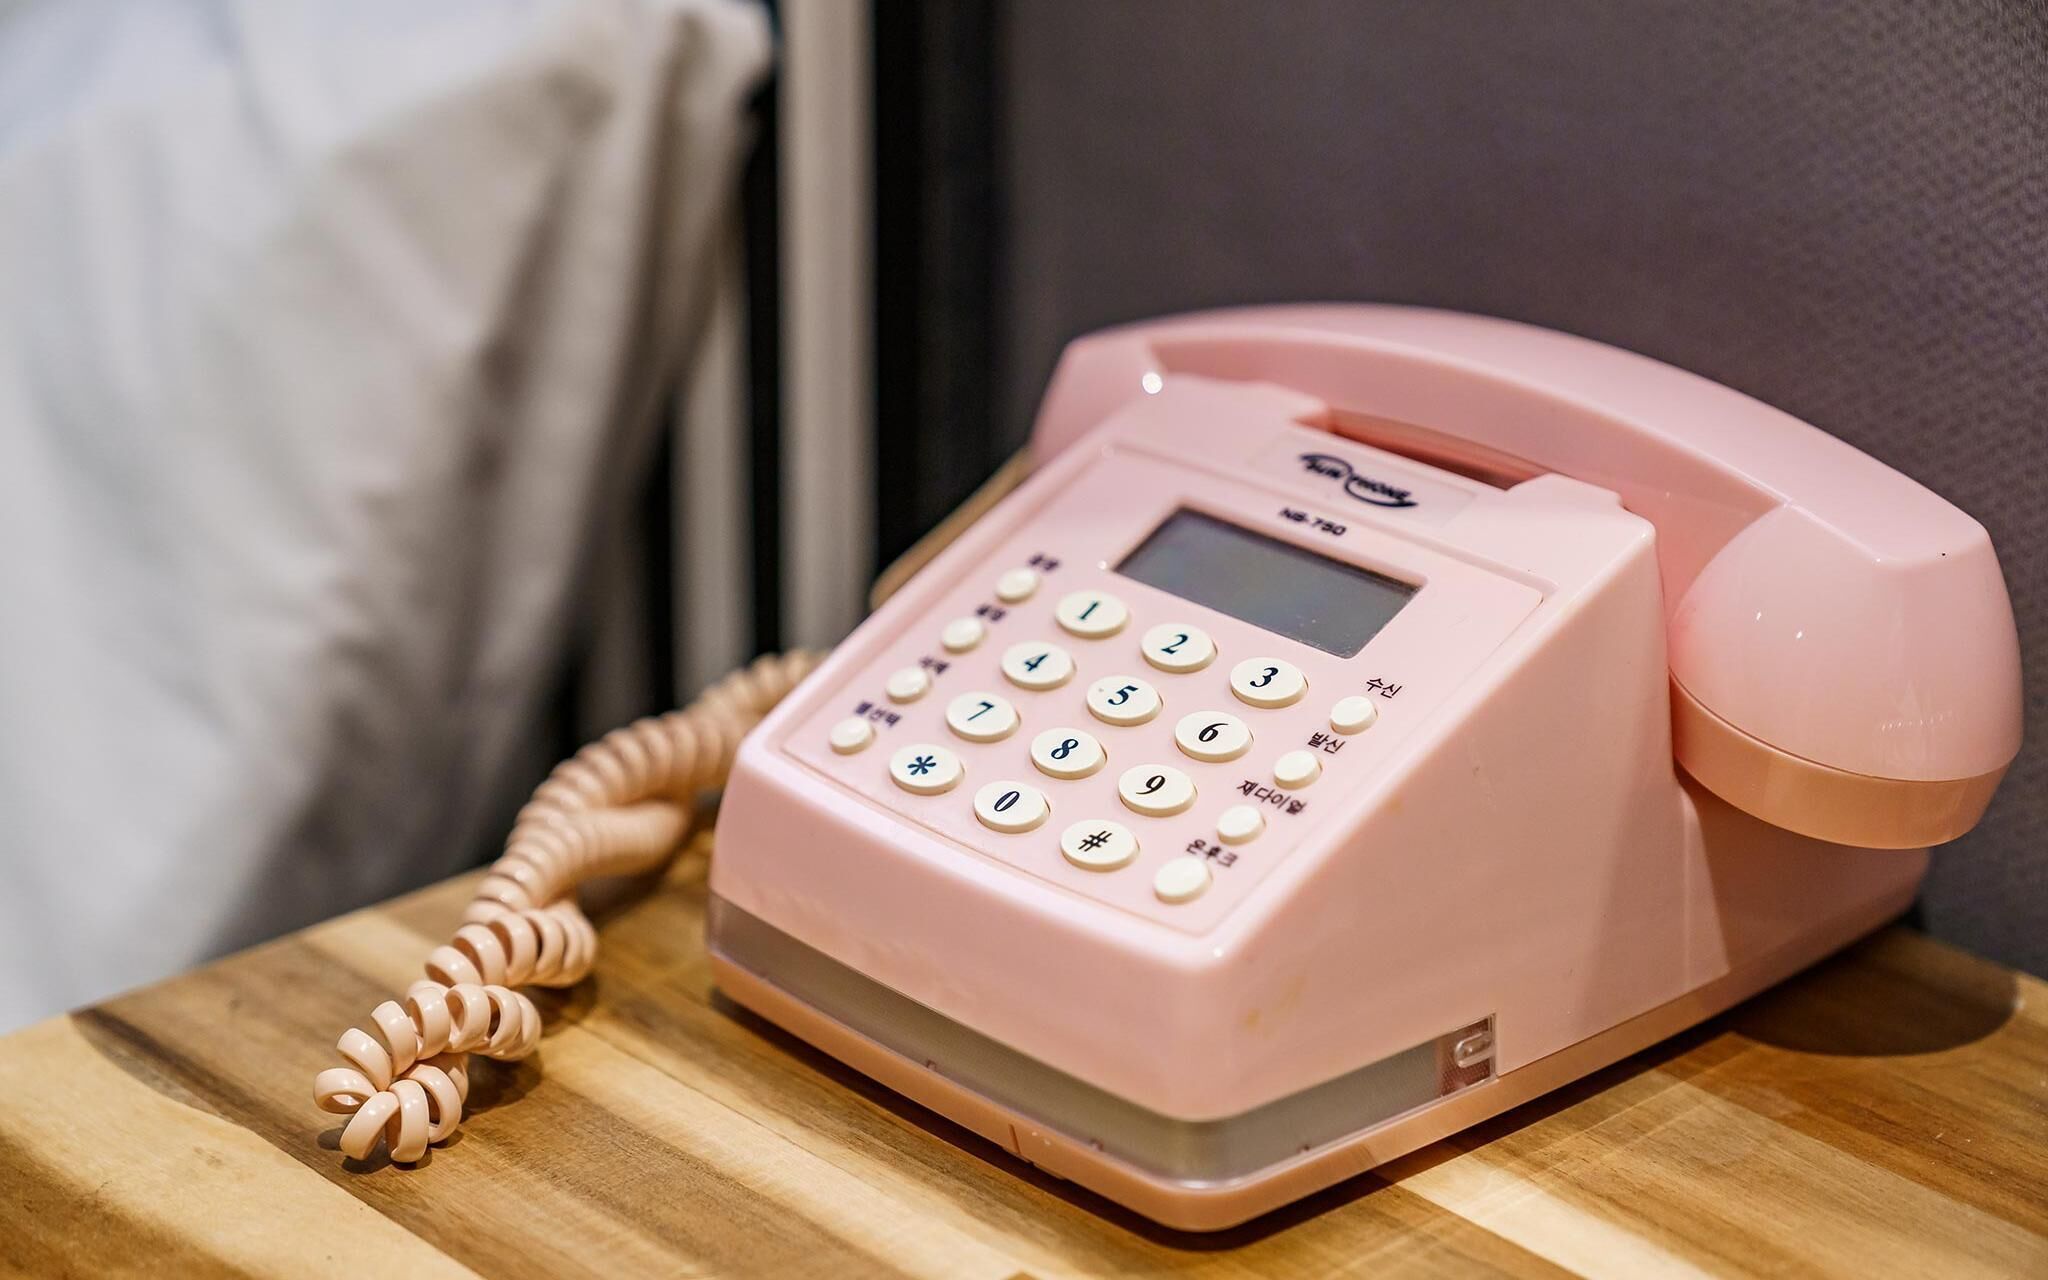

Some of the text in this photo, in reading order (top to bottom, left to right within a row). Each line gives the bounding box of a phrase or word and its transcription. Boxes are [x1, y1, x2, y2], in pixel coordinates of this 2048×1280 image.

[1079, 601, 1099, 620] 1
[1161, 633, 1189, 655] 2
[1024, 653, 1049, 672] 4
[1249, 666, 1279, 688] 3
[1366, 677, 1403, 699] 수신
[1107, 685, 1139, 706] 5
[967, 701, 995, 721] 7
[1198, 722, 1229, 743] 6
[1307, 731, 1347, 754] 발신
[1050, 738, 1079, 760] 8
[1135, 774, 1166, 795] 9
[993, 790, 1021, 812] 0
[1236, 779, 1307, 815] 재다이얼
[1078, 830, 1113, 853] #
[1186, 837, 1238, 868] 온후크
